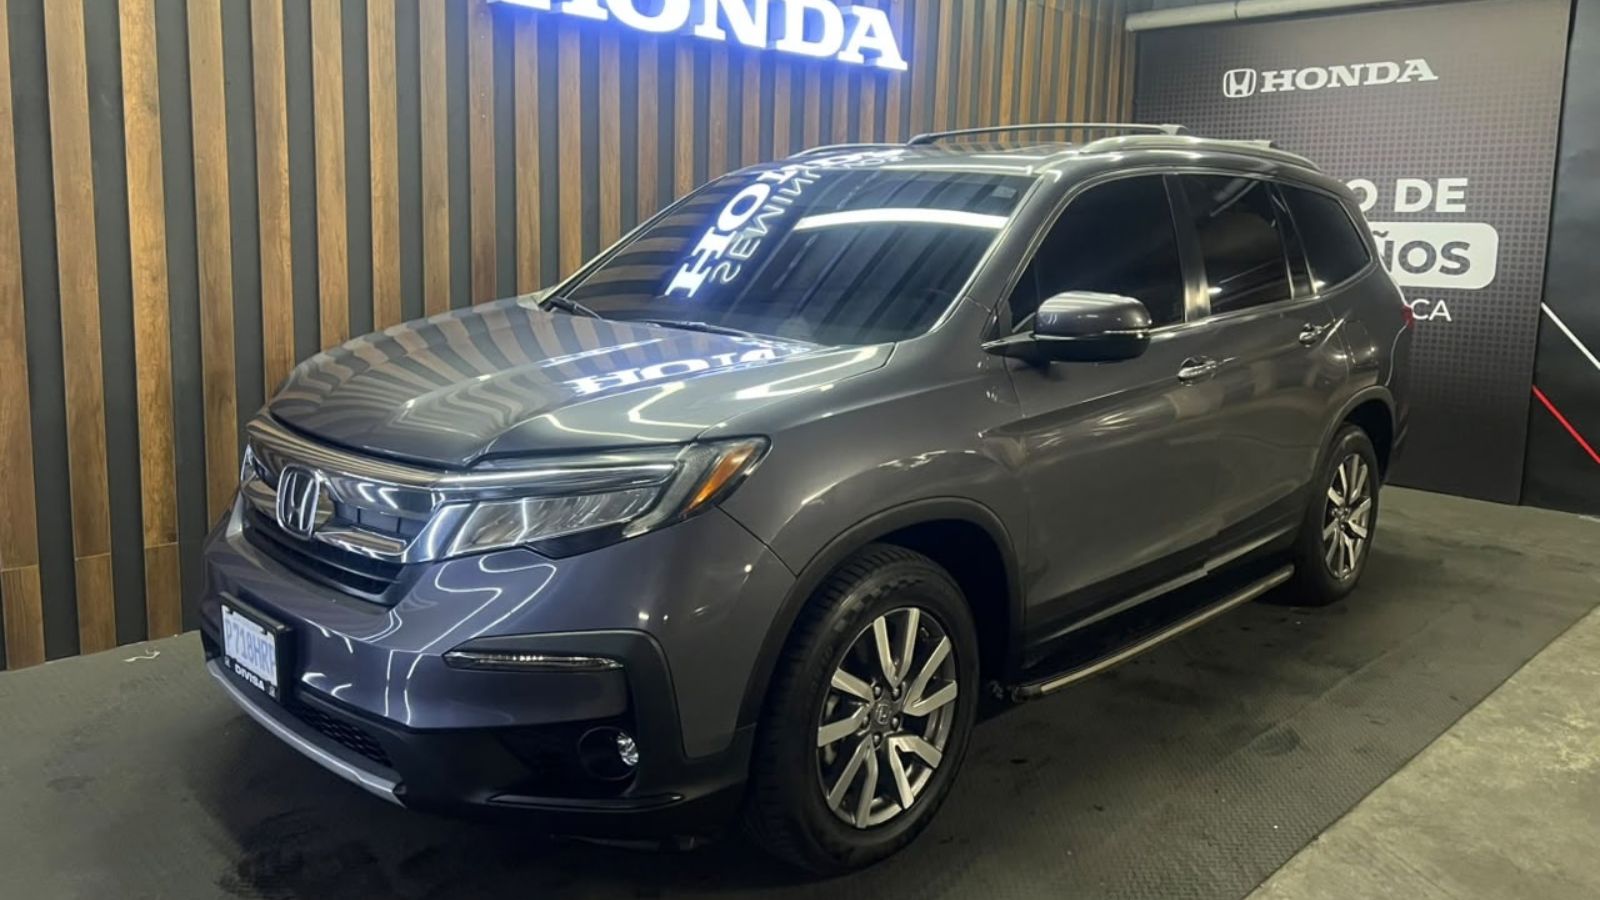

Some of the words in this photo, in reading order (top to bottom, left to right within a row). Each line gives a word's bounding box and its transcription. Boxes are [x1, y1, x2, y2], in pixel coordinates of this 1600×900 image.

[487, 0, 908, 71] ONDA
[1260, 58, 1439, 93] HONDA
[1346, 178, 1378, 212] O
[1394, 177, 1469, 213] DE
[235, 664, 265, 691] DIVISA
